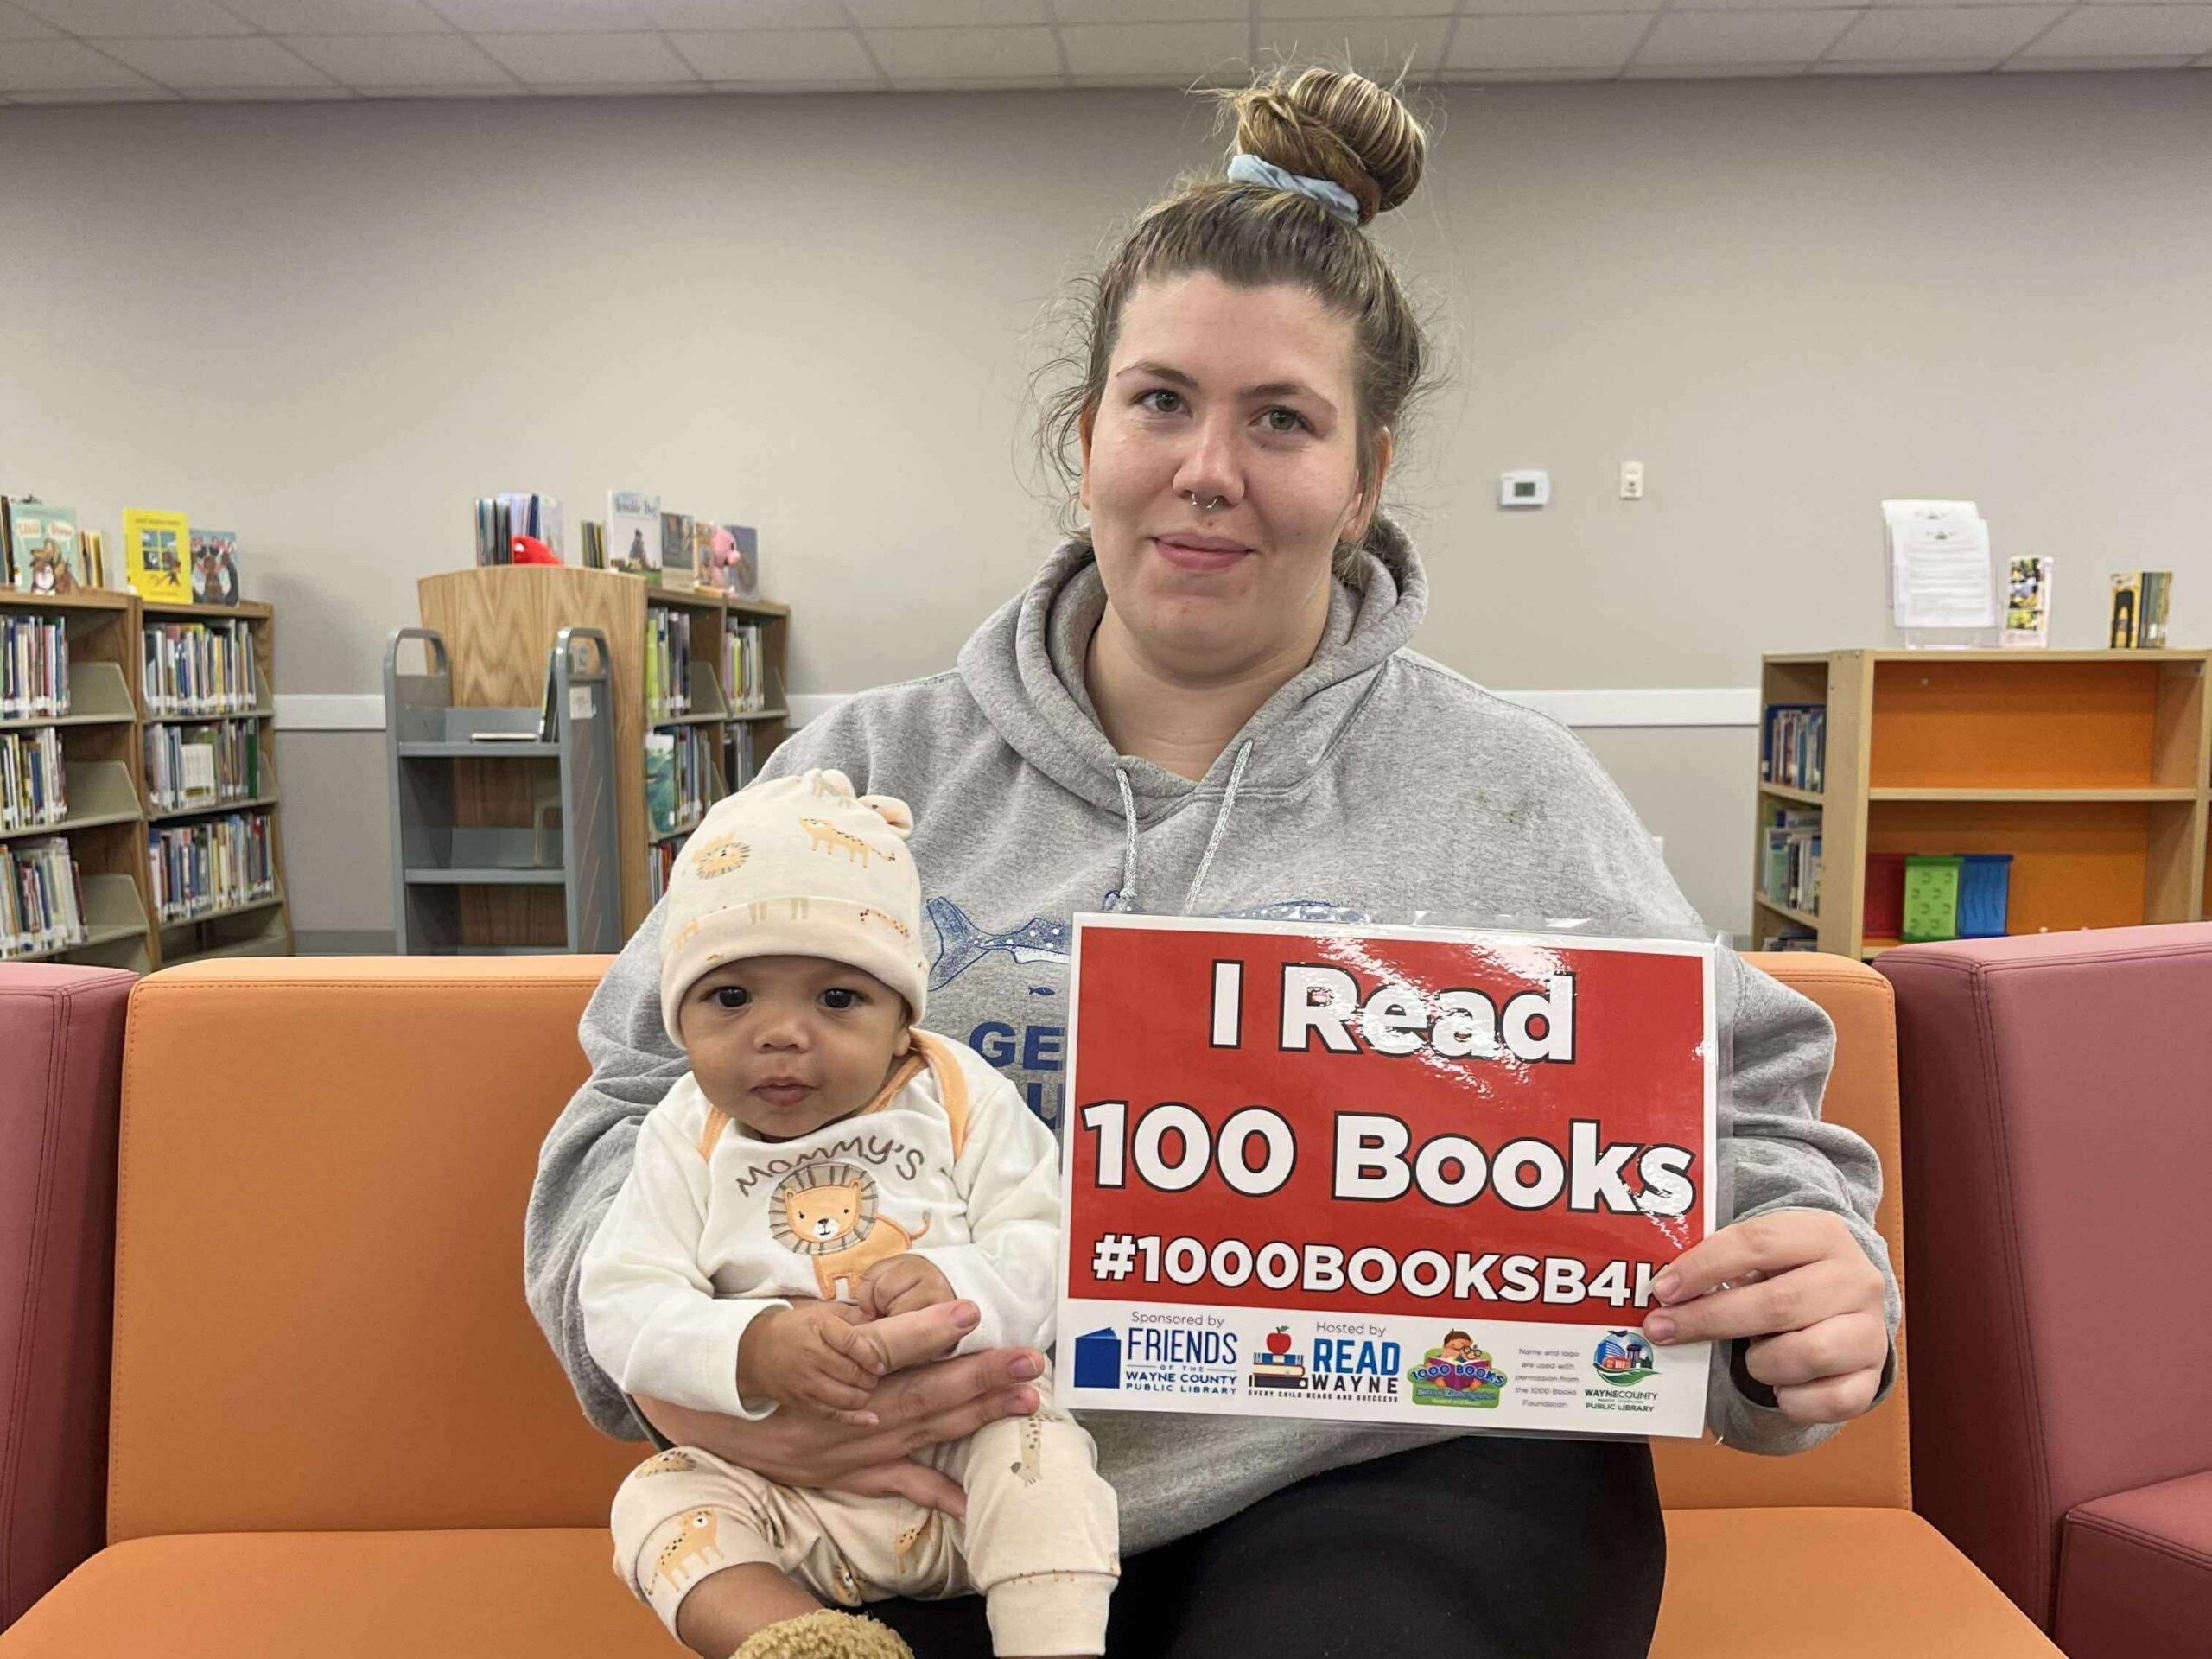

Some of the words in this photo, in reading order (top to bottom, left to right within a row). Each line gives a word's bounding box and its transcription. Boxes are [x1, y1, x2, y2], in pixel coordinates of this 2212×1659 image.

[1210, 959, 1243, 1049] I
[1279, 962, 1577, 1064] Read
[1082, 1100, 1296, 1198] 100
[1331, 1111, 1696, 1217] Books
[1131, 1311, 1204, 1325] Sponsored
[1207, 1315, 1225, 1328] by
[1316, 1321, 1364, 1335] Hosted
[1369, 1324, 1386, 1337] by
[1127, 1327, 1238, 1365] FRIENDS
[1519, 1348, 1542, 1357] Name
[1561, 1350, 1580, 1358] logo
[1313, 1338, 1401, 1376] READ
[1126, 1370, 1176, 1382] WAYNE
[1180, 1373, 1238, 1385] COUNTY
[1411, 1364, 1451, 1382] 1000
[1455, 1364, 1504, 1386] BOOKS
[1515, 1374, 1558, 1382] permission
[1560, 1374, 1580, 1382] from
[1126, 1382, 1174, 1392] PUBLIC
[1180, 1384, 1238, 1395] LIBRARY
[1312, 1373, 1399, 1395] WAYNE
[1306, 1392, 1333, 1401] READS
[1552, 1388, 1578, 1396] Books
[1522, 1400, 1568, 1408] Foundation
[1586, 1402, 1616, 1411] PUBLIC
[1618, 1403, 1655, 1413] LIBRARY
